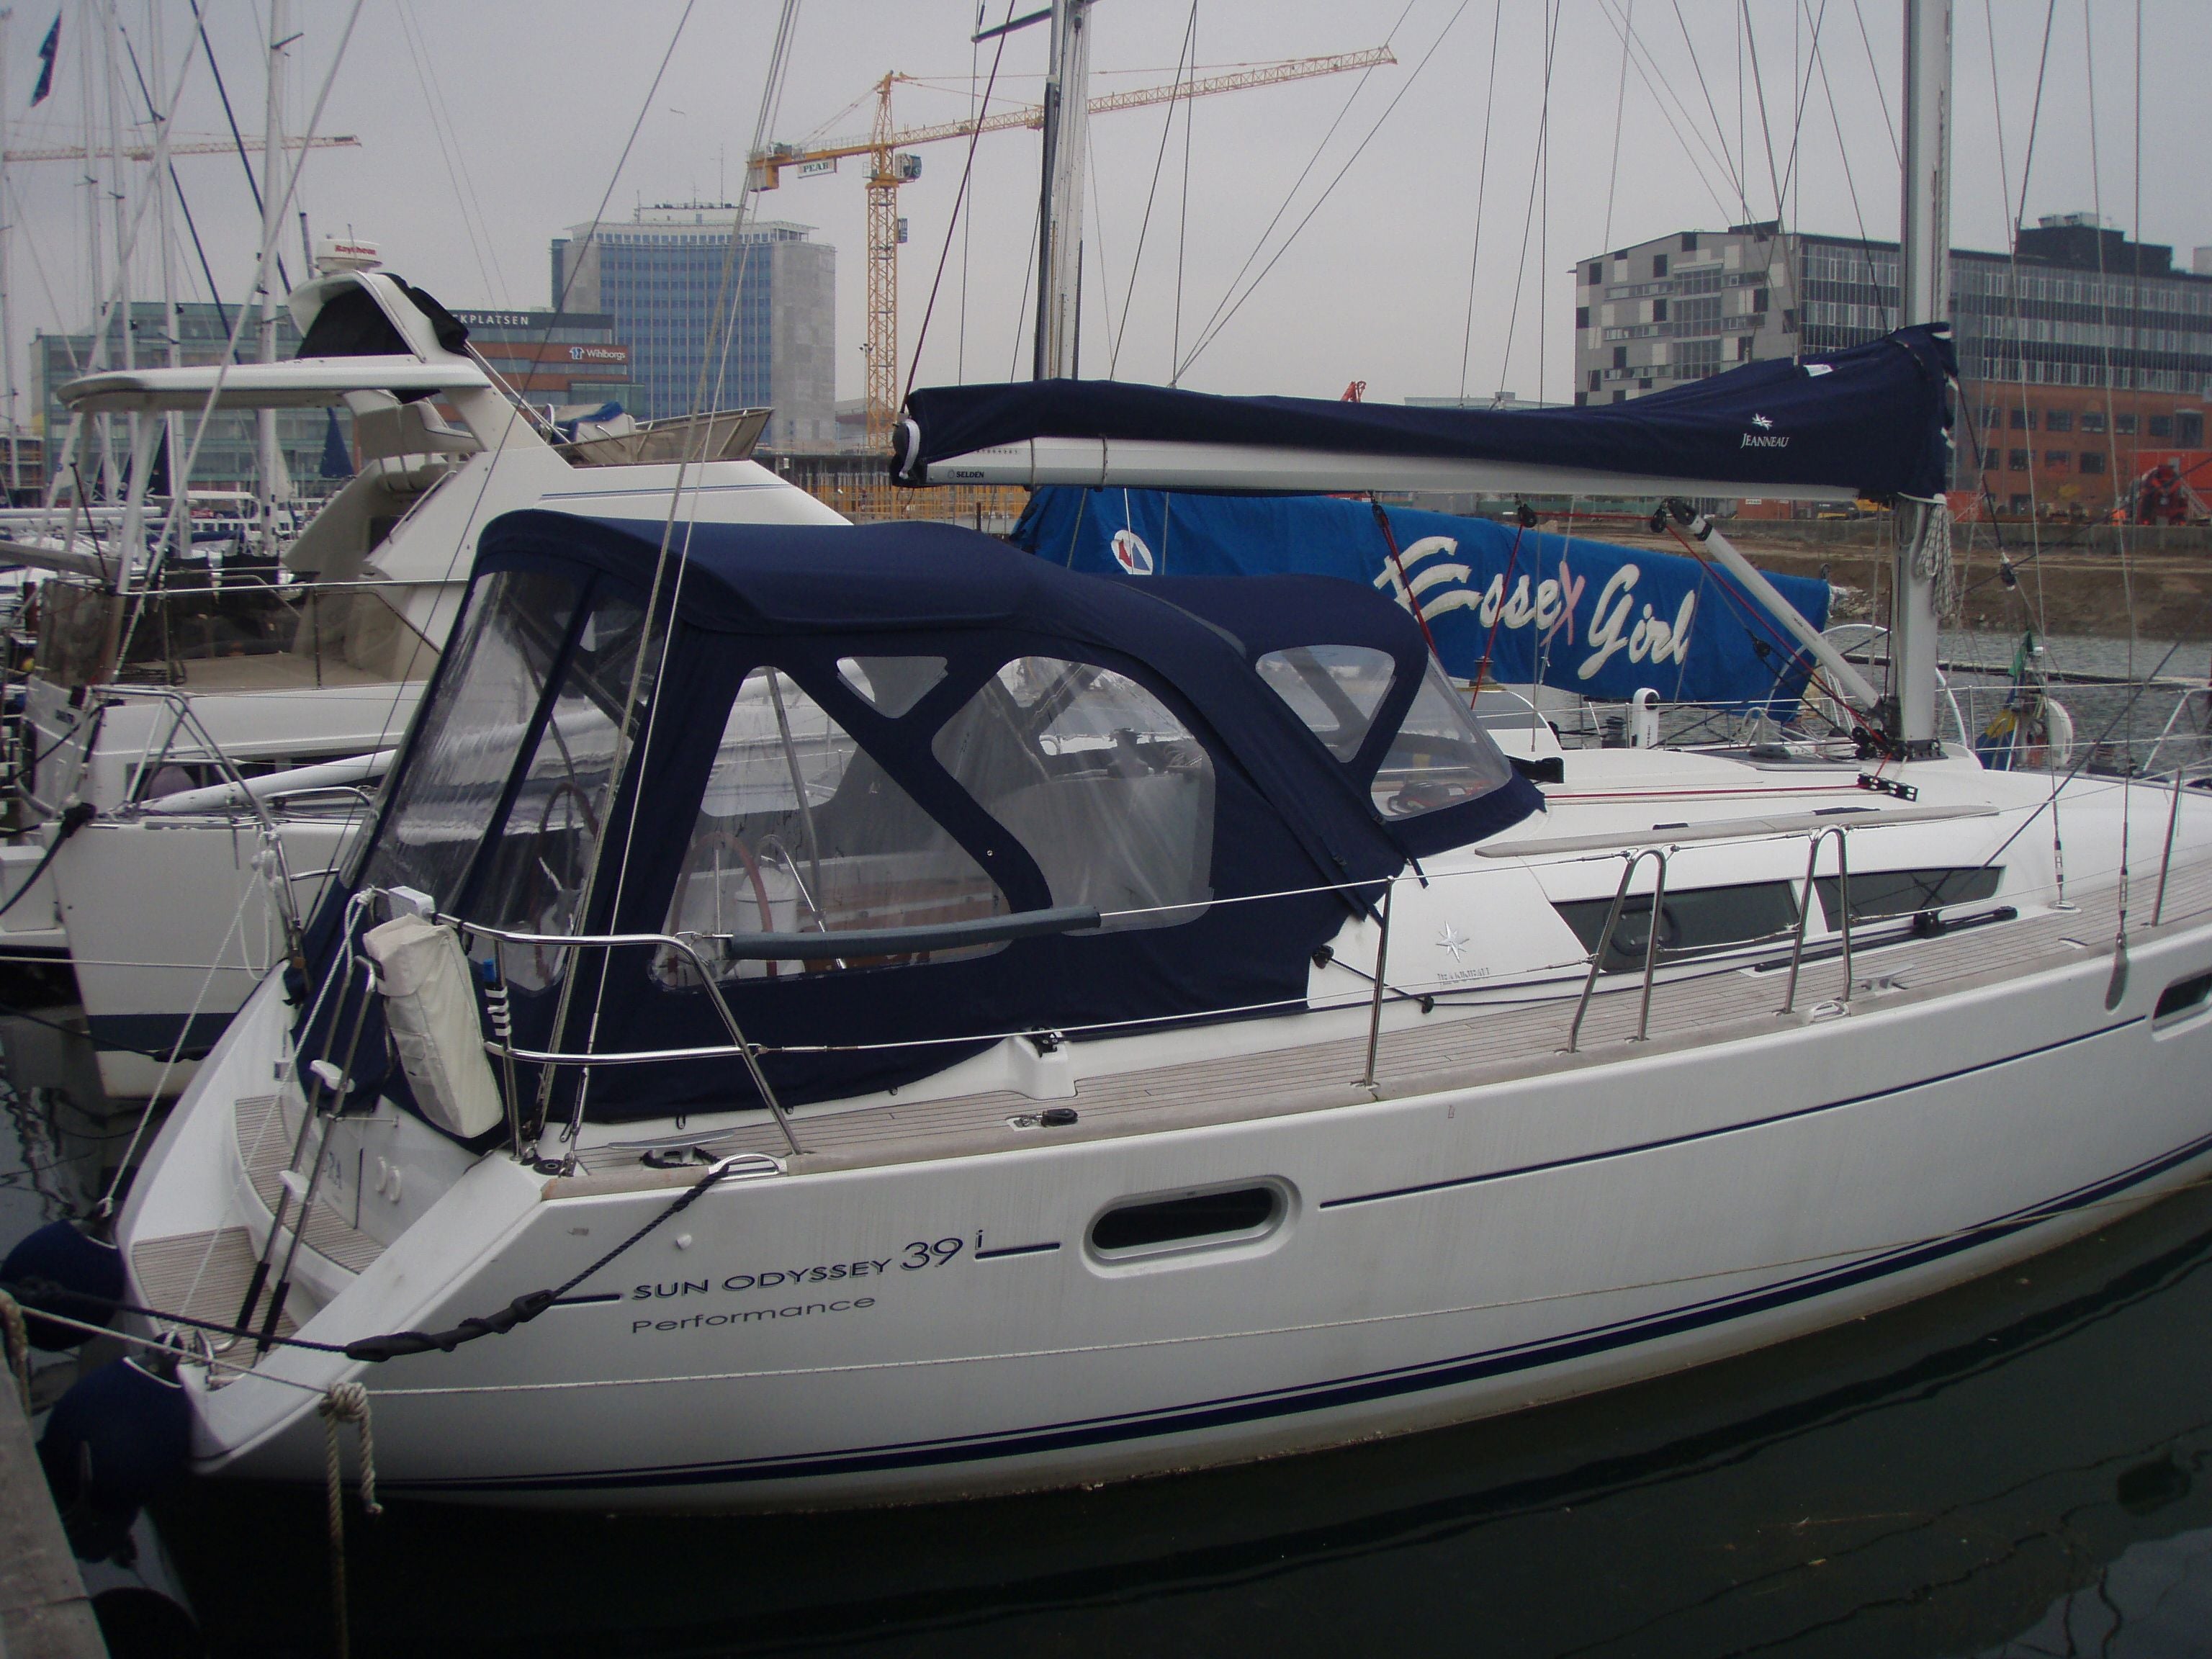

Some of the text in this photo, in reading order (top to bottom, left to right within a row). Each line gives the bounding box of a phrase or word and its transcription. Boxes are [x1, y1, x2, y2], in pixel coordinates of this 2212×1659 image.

[586, 349, 626, 360] Wihlborgs
[1578, 564, 1696, 680] Girl
[633, 1280, 709, 1300] SUN
[721, 1258, 892, 1292] ODYSSEY
[900, 1237, 963, 1272] 39
[632, 1297, 876, 1334] Performance
